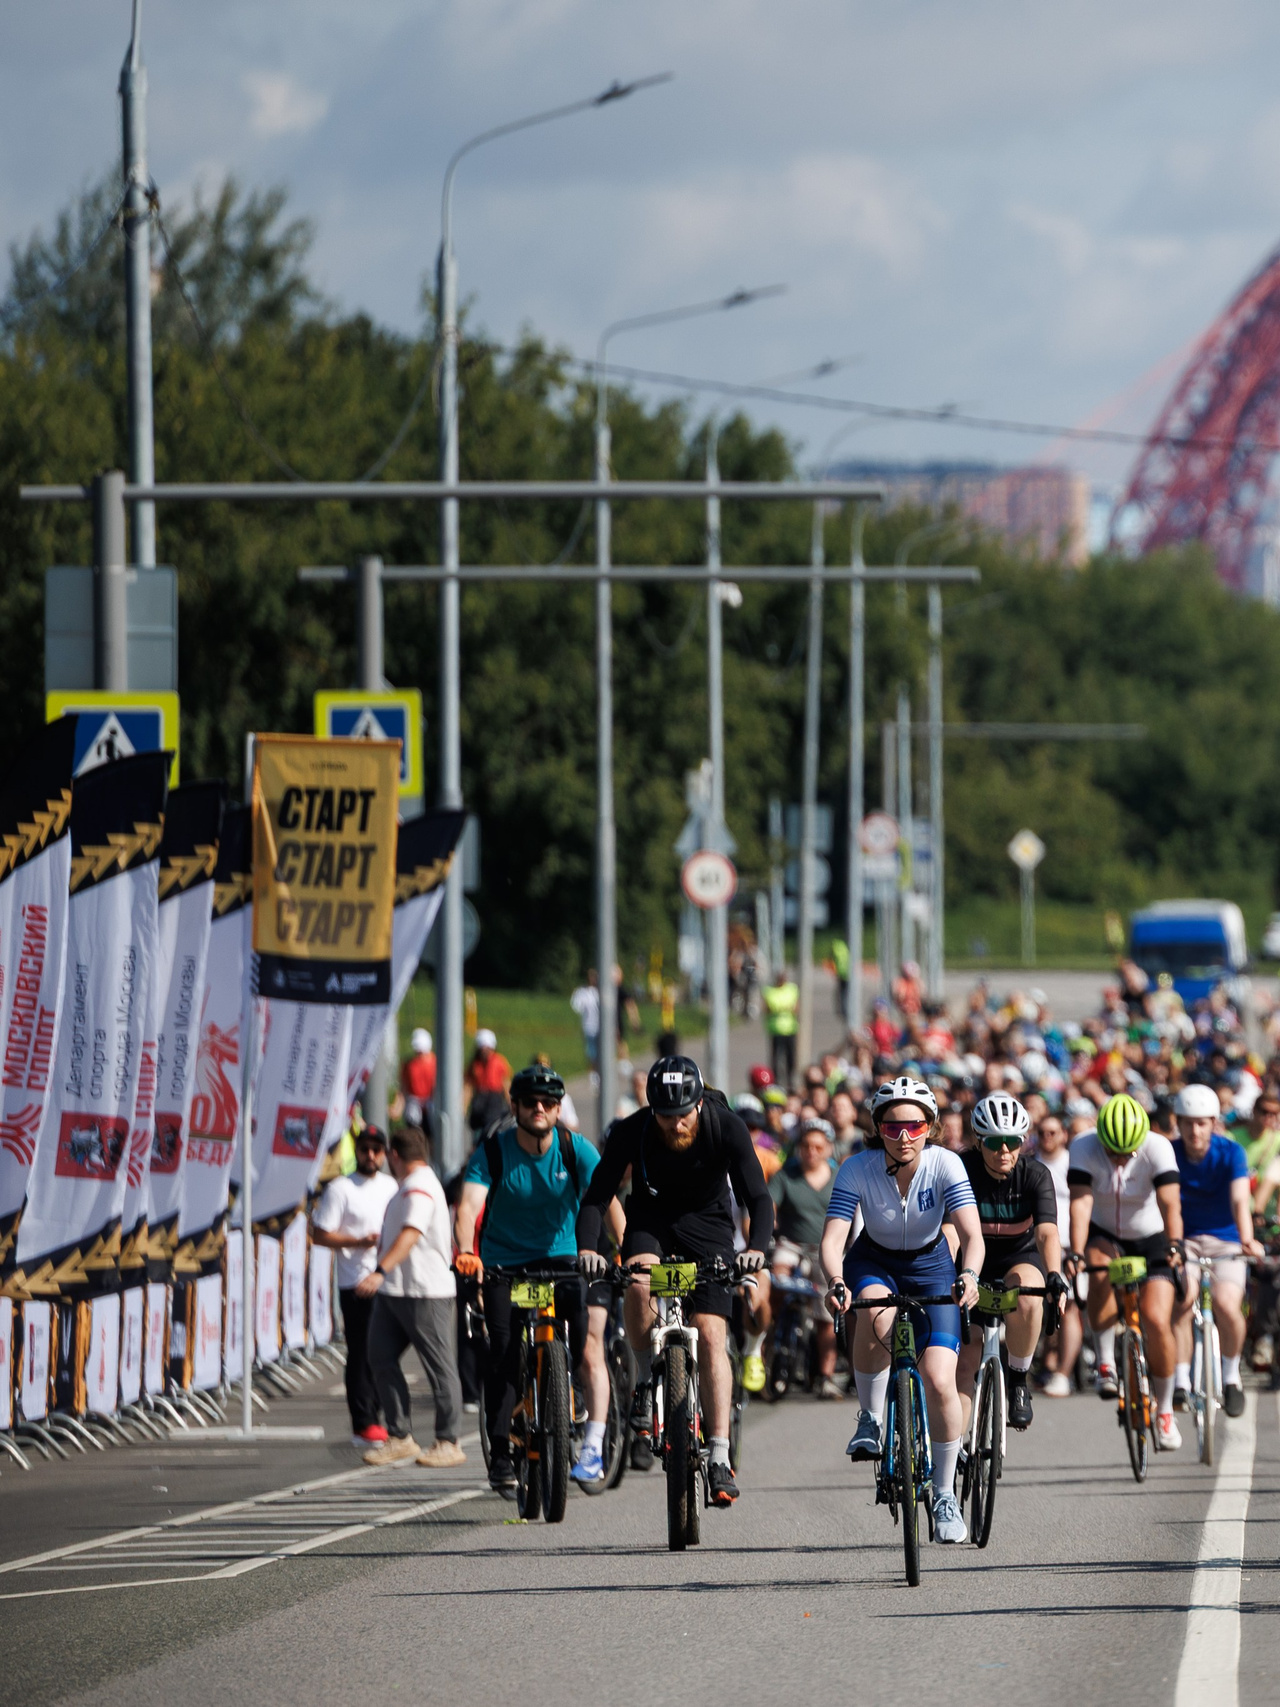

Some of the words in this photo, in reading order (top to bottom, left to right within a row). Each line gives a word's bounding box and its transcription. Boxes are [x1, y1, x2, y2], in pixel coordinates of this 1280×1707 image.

[276, 786, 376, 835] СТАРТ
[274, 840, 378, 891] СТАРТ
[275, 897, 375, 947] СТАРТ
[2, 903, 48, 1088] МОСКОВСКИЙ
[116, 944, 137, 1027] Москвы
[174, 955, 196, 1031] Москвы
[26, 1004, 56, 1092] СПОРТ
[66, 961, 88, 1098] Департамент
[90, 1028, 109, 1100] спорта
[115, 1030, 133, 1102] города
[171, 1032, 190, 1100] города
[902, 1088, 907, 1096] 3
[1003, 1118, 1008, 1126] 2
[527, 1286, 540, 1300] 15
[665, 1269, 681, 1288] 14
[991, 1297, 1001, 1309] 2
[900, 1328, 910, 1348] 3
